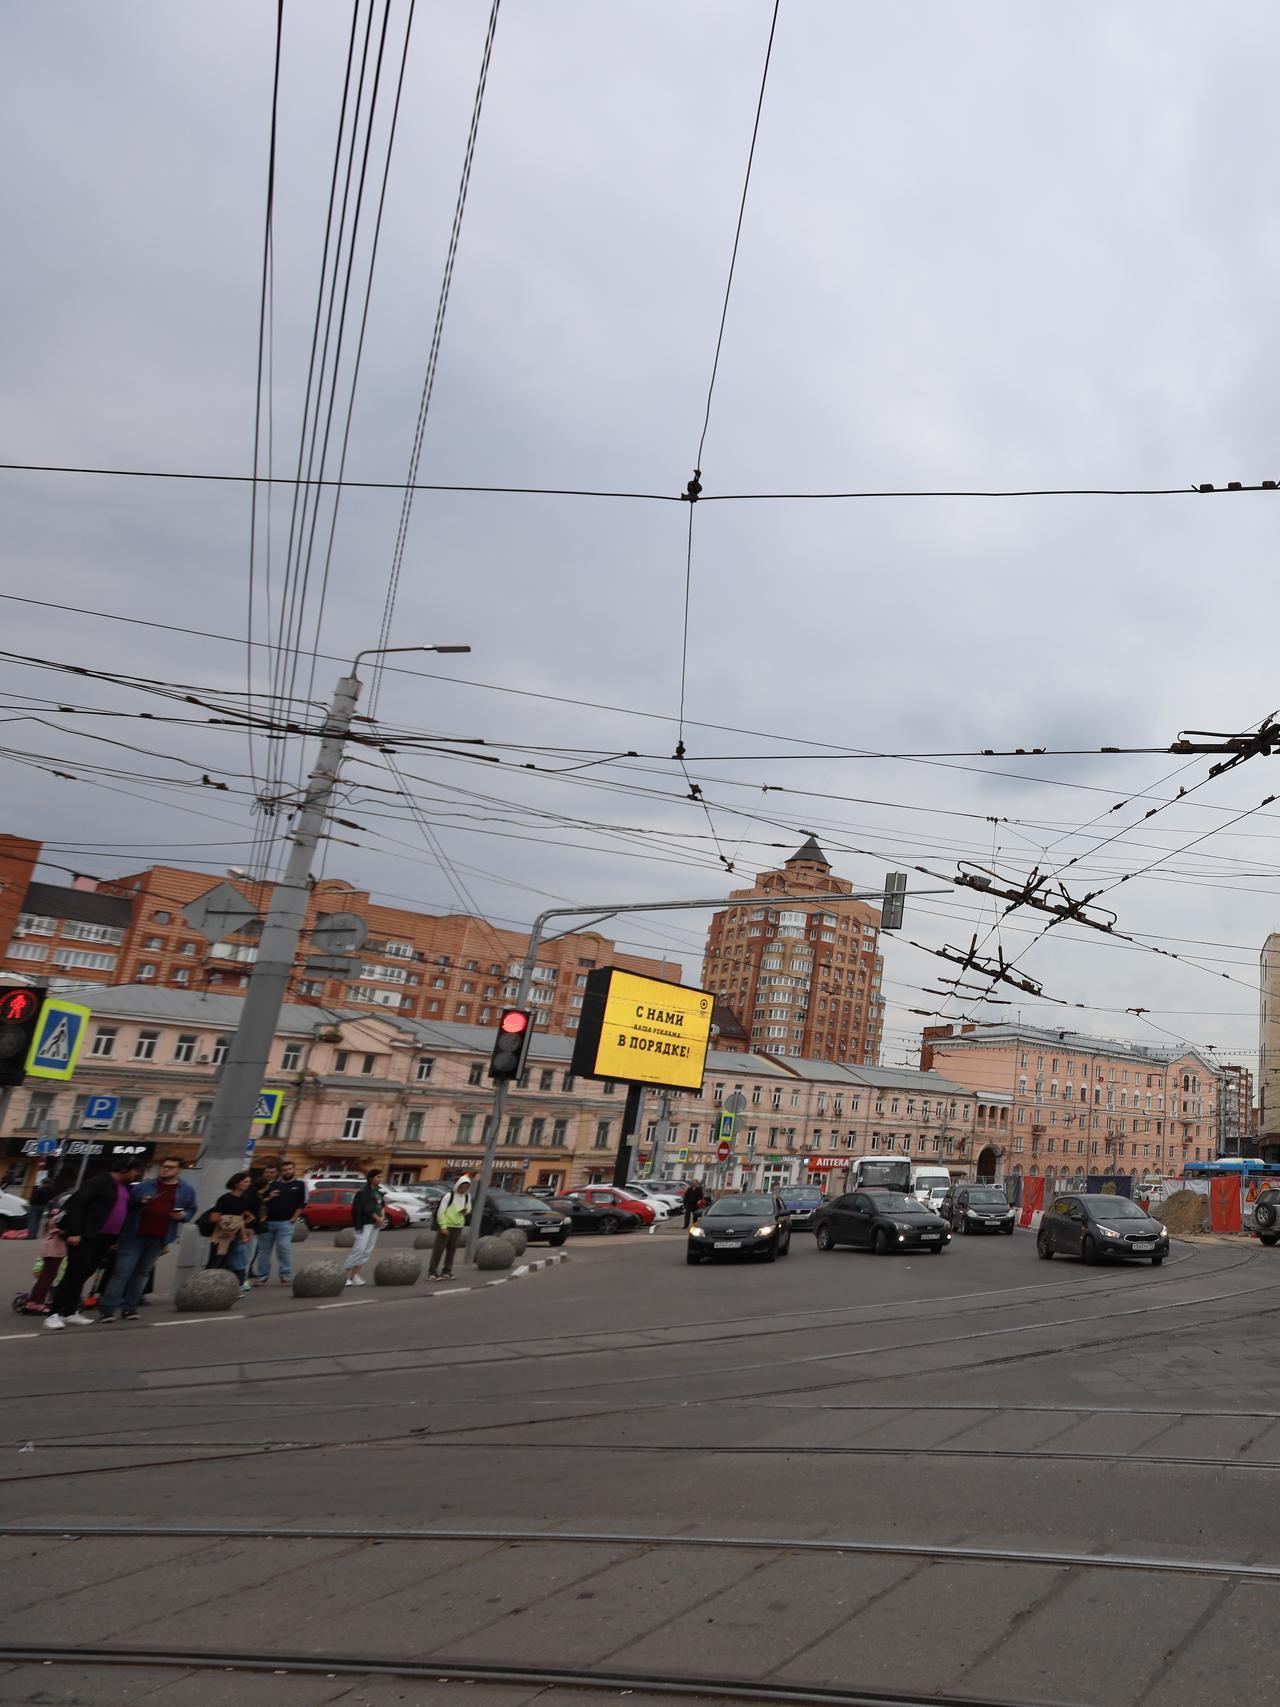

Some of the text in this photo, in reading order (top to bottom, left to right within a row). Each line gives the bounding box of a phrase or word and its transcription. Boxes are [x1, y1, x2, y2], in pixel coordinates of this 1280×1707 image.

[636, 1005, 644, 1018] С
[646, 1008, 684, 1027] НАМИ
[617, 1034, 690, 1058] В ПОРЯДКЕ!
[112, 1145, 147, 1154] БАР
[816, 1157, 849, 1167] АПТЕКА
